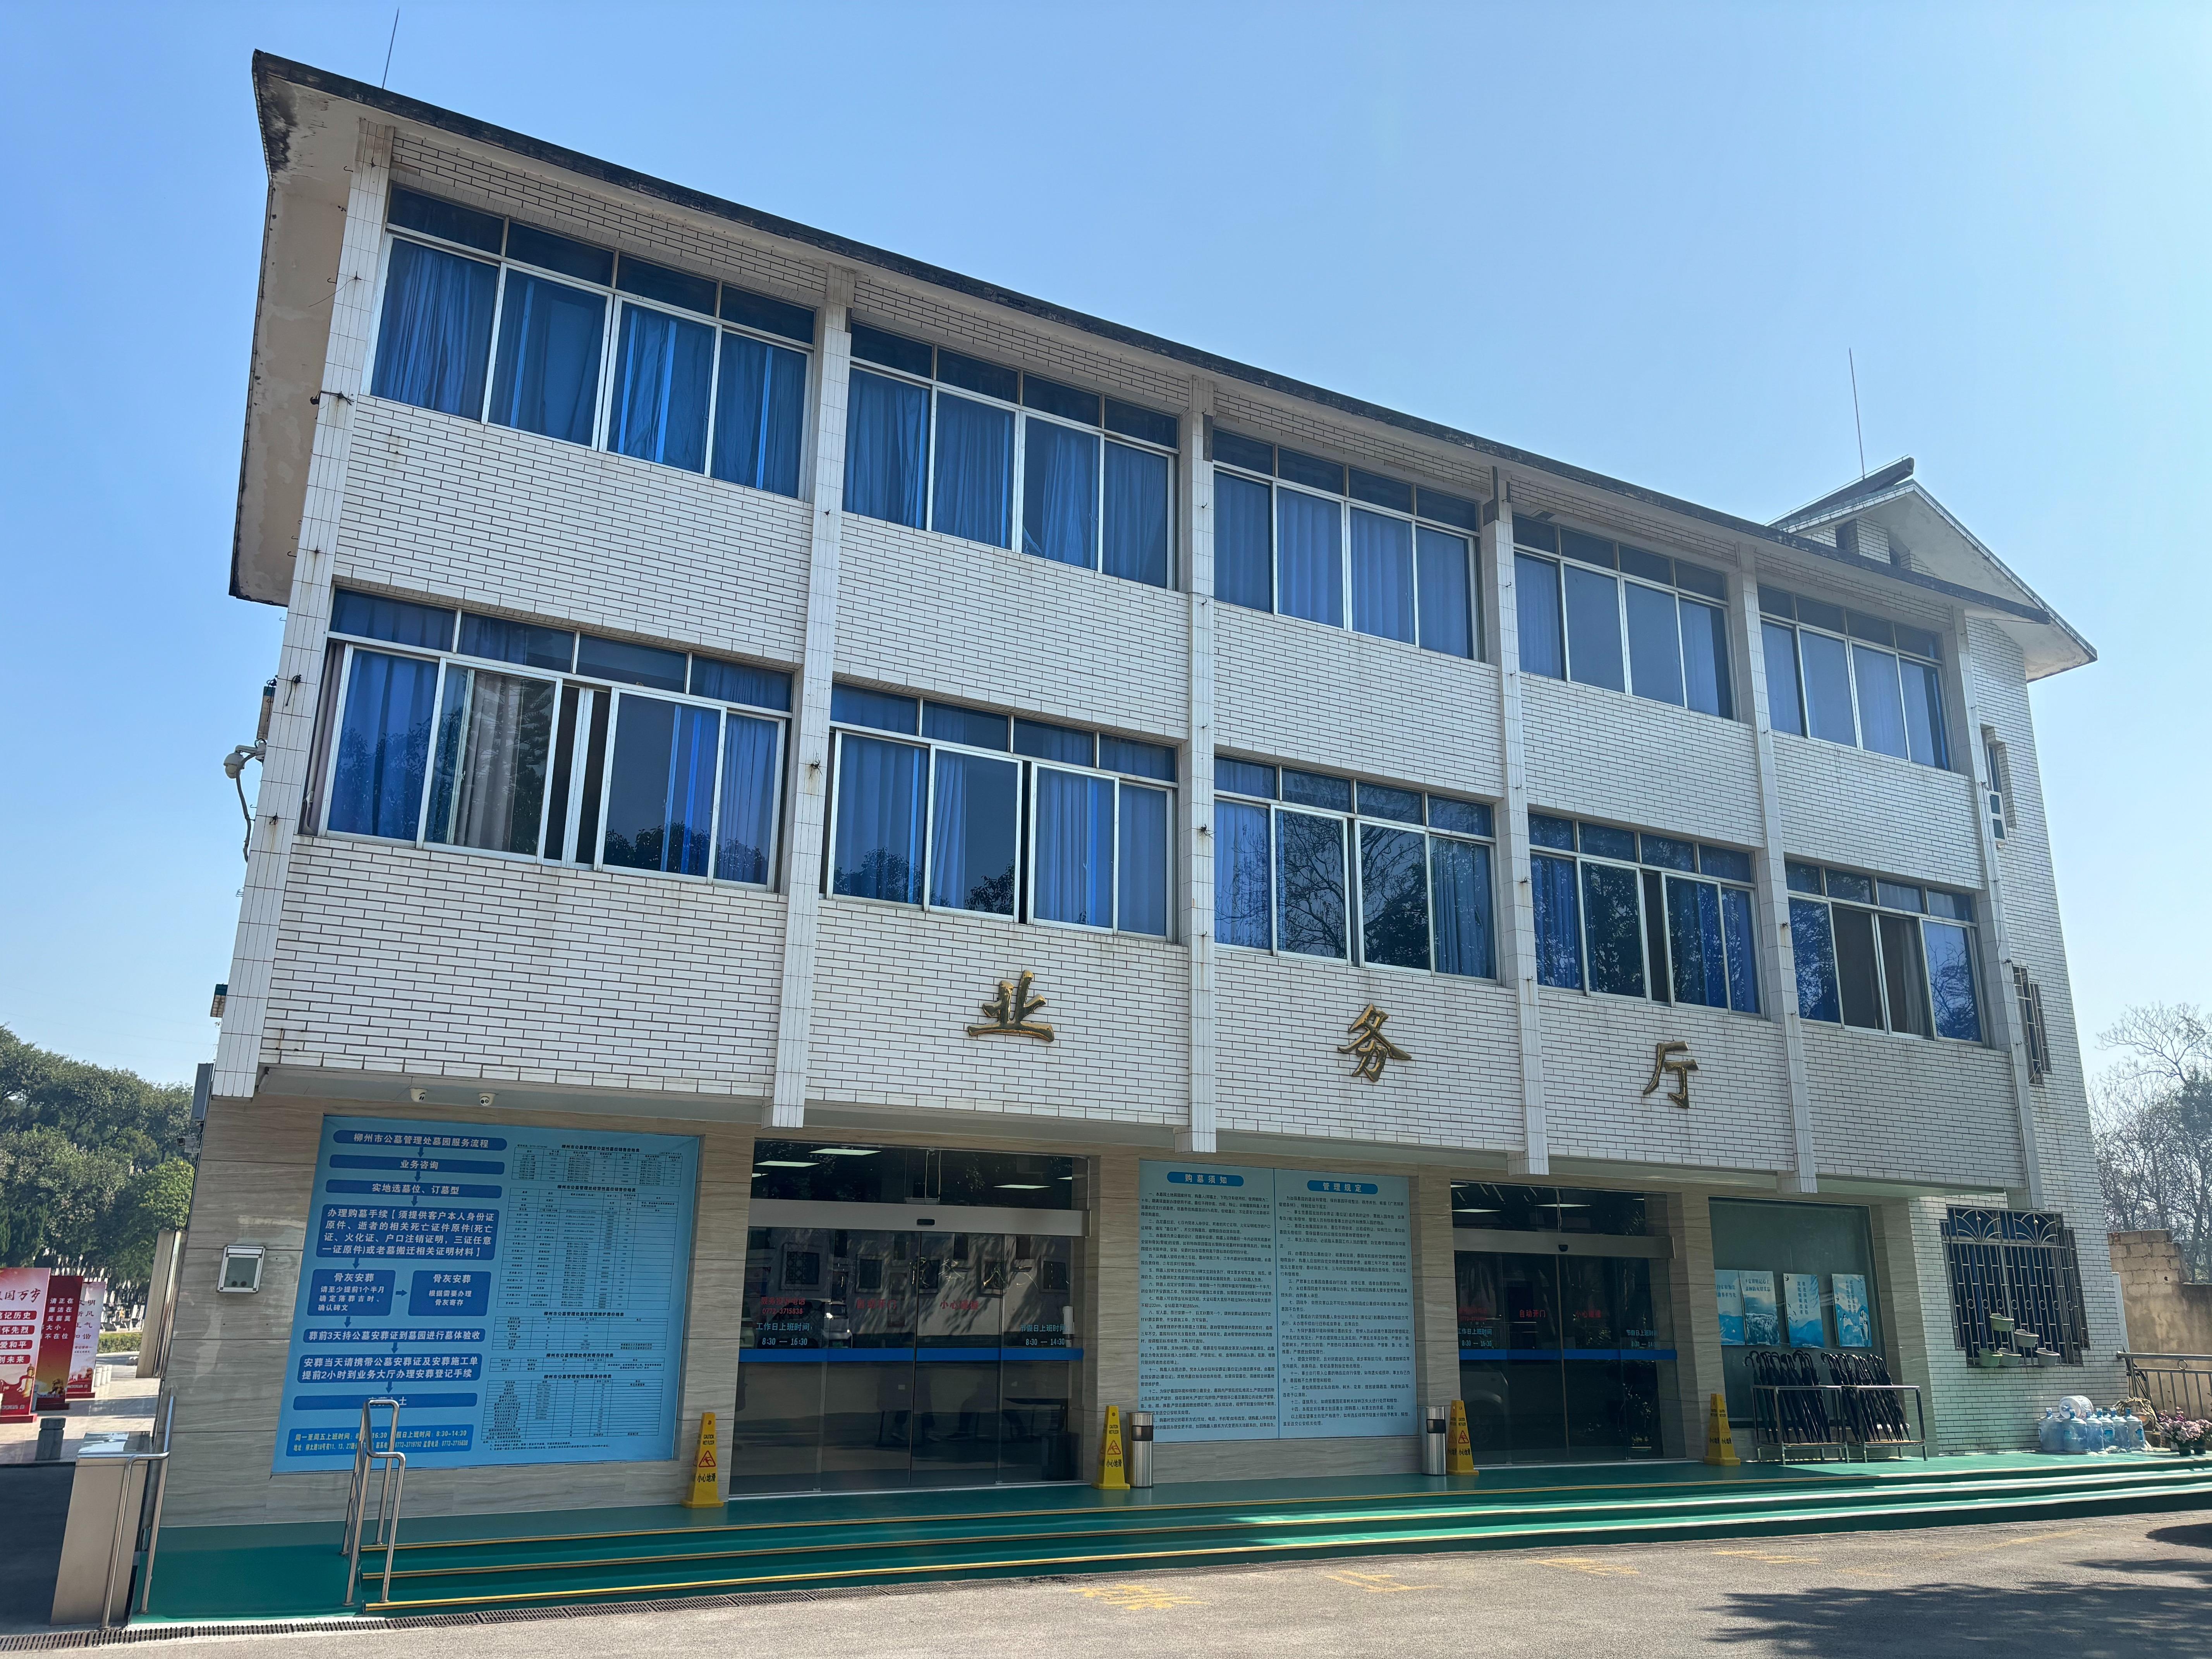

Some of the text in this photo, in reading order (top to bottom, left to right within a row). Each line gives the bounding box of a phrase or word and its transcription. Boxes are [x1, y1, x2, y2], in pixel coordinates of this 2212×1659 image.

[967, 969, 1700, 1108] 业 务 厅
[354, 1133, 489, 1148] 柳州市公墓管理处墓园服务流程
[400, 1160, 438, 1170] 业务咨询
[1185, 1174, 1227, 1184] 购墓须知
[372, 1183, 459, 1195] 实地选墓位、订墓型
[1323, 1182, 1362, 1193] 管理规定
[334, 1273, 374, 1283] 骨灰安葬
[433, 1274, 472, 1284] 骨灰安葬
[320, 1285, 385, 1293] 请至少提前1个半月
[1519, 1309, 1546, 1317] 自动开门
[308, 1331, 481, 1341] 葬前3天持公墓安葬证到墓园进行墓体验收
[304, 1356, 478, 1367] 安葬当天请携带公墓安葬证及安葬施工单
[301, 1369, 472, 1380] 提前2小时到业务大厅办理安葬登记手续
[1106, 1459, 1122, 1467] 小心地滑
[697, 1473, 716, 1483] 小心地滑
